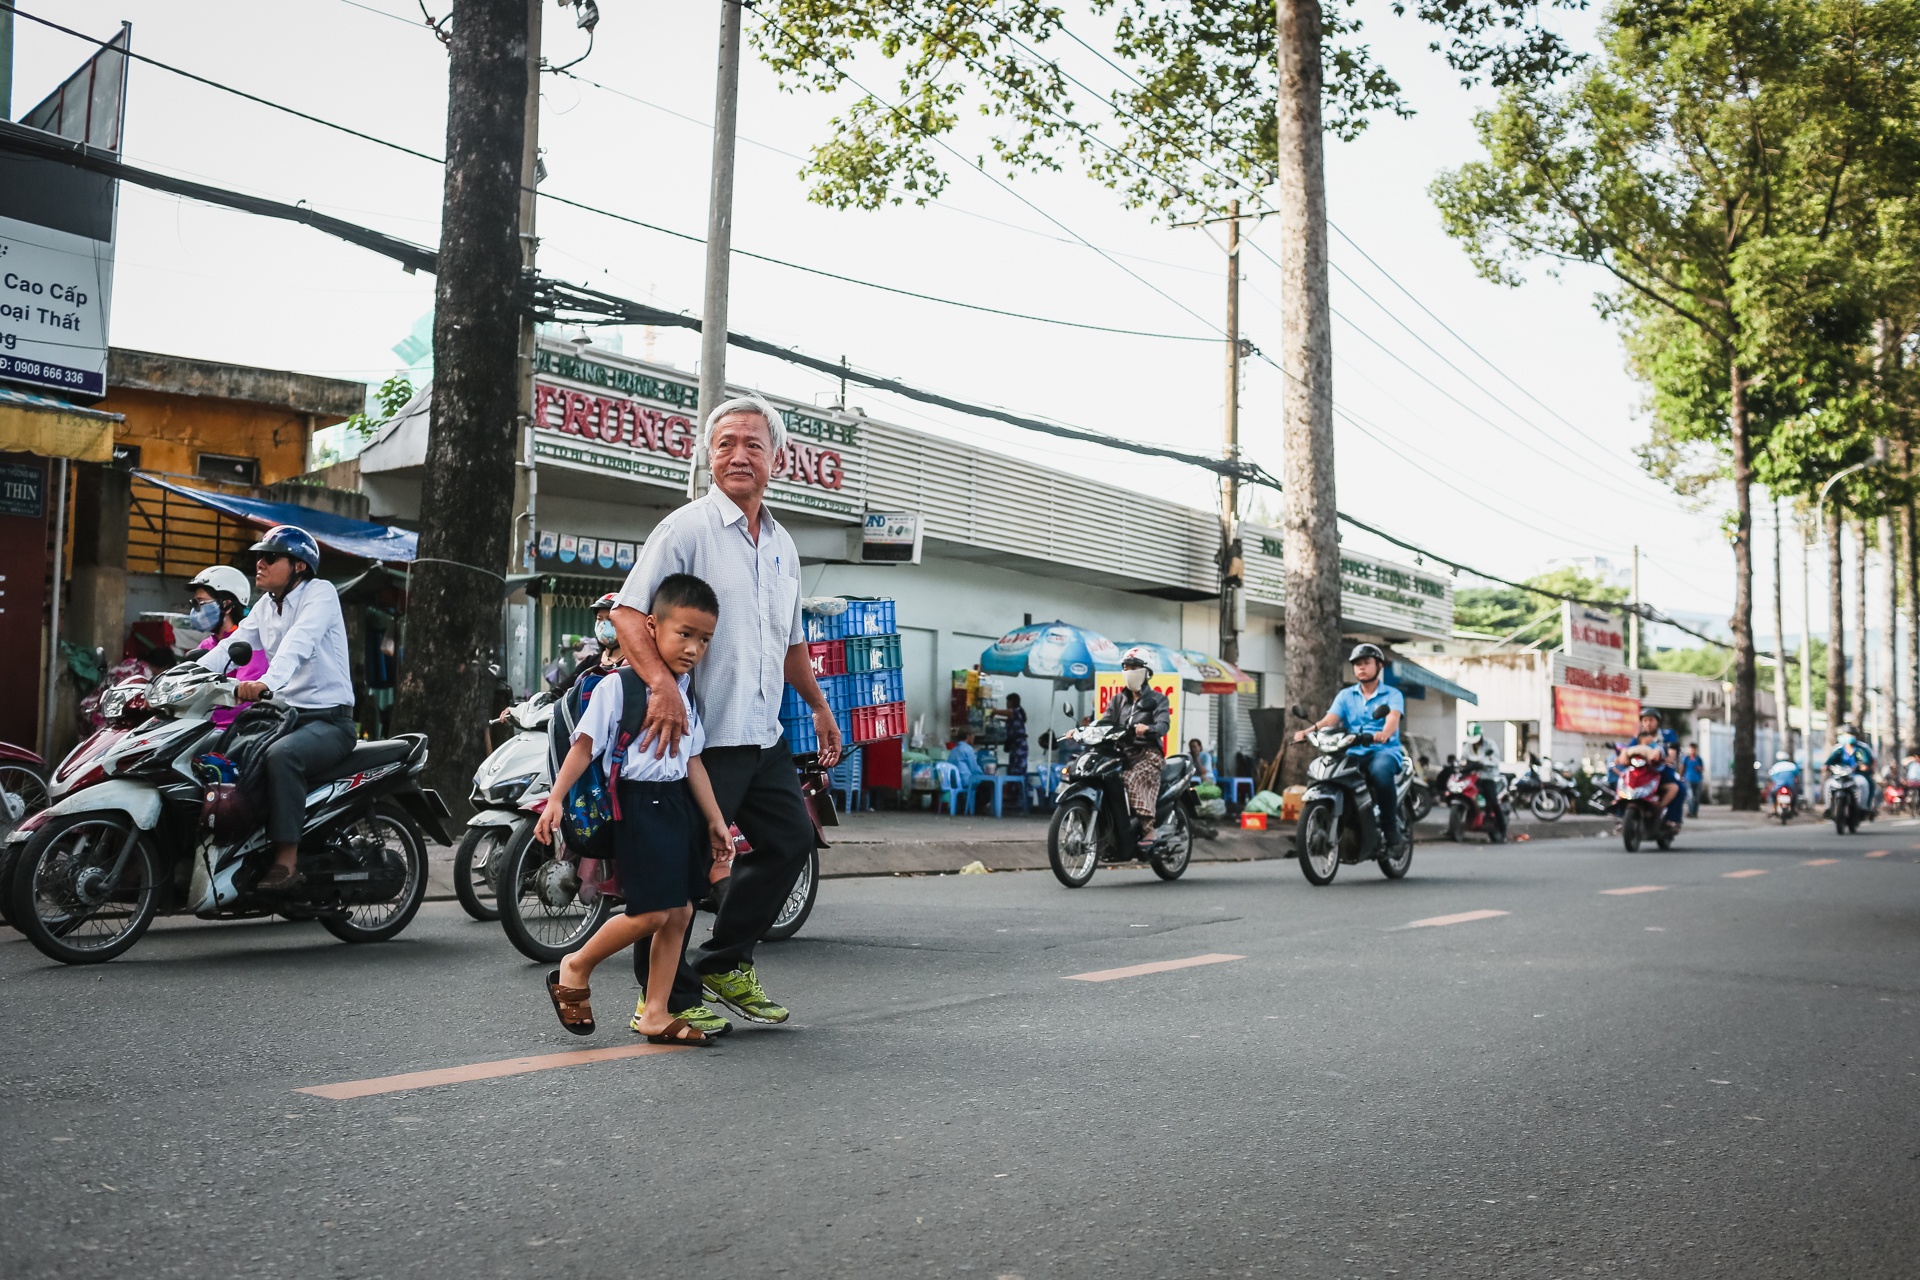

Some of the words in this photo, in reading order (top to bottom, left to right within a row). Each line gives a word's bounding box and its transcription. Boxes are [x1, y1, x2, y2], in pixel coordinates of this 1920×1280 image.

[4, 273, 44, 295] Cao
[50, 283, 88, 307] Cấp
[0, 303, 30, 322] oại
[37, 308, 81, 331] Thất
[14, 360, 41, 375] 0908
[43, 367, 62, 380] 666
[65, 371, 84, 384] 336
[5, 479, 38, 501] THÌN
[865, 515, 886, 527] AND
